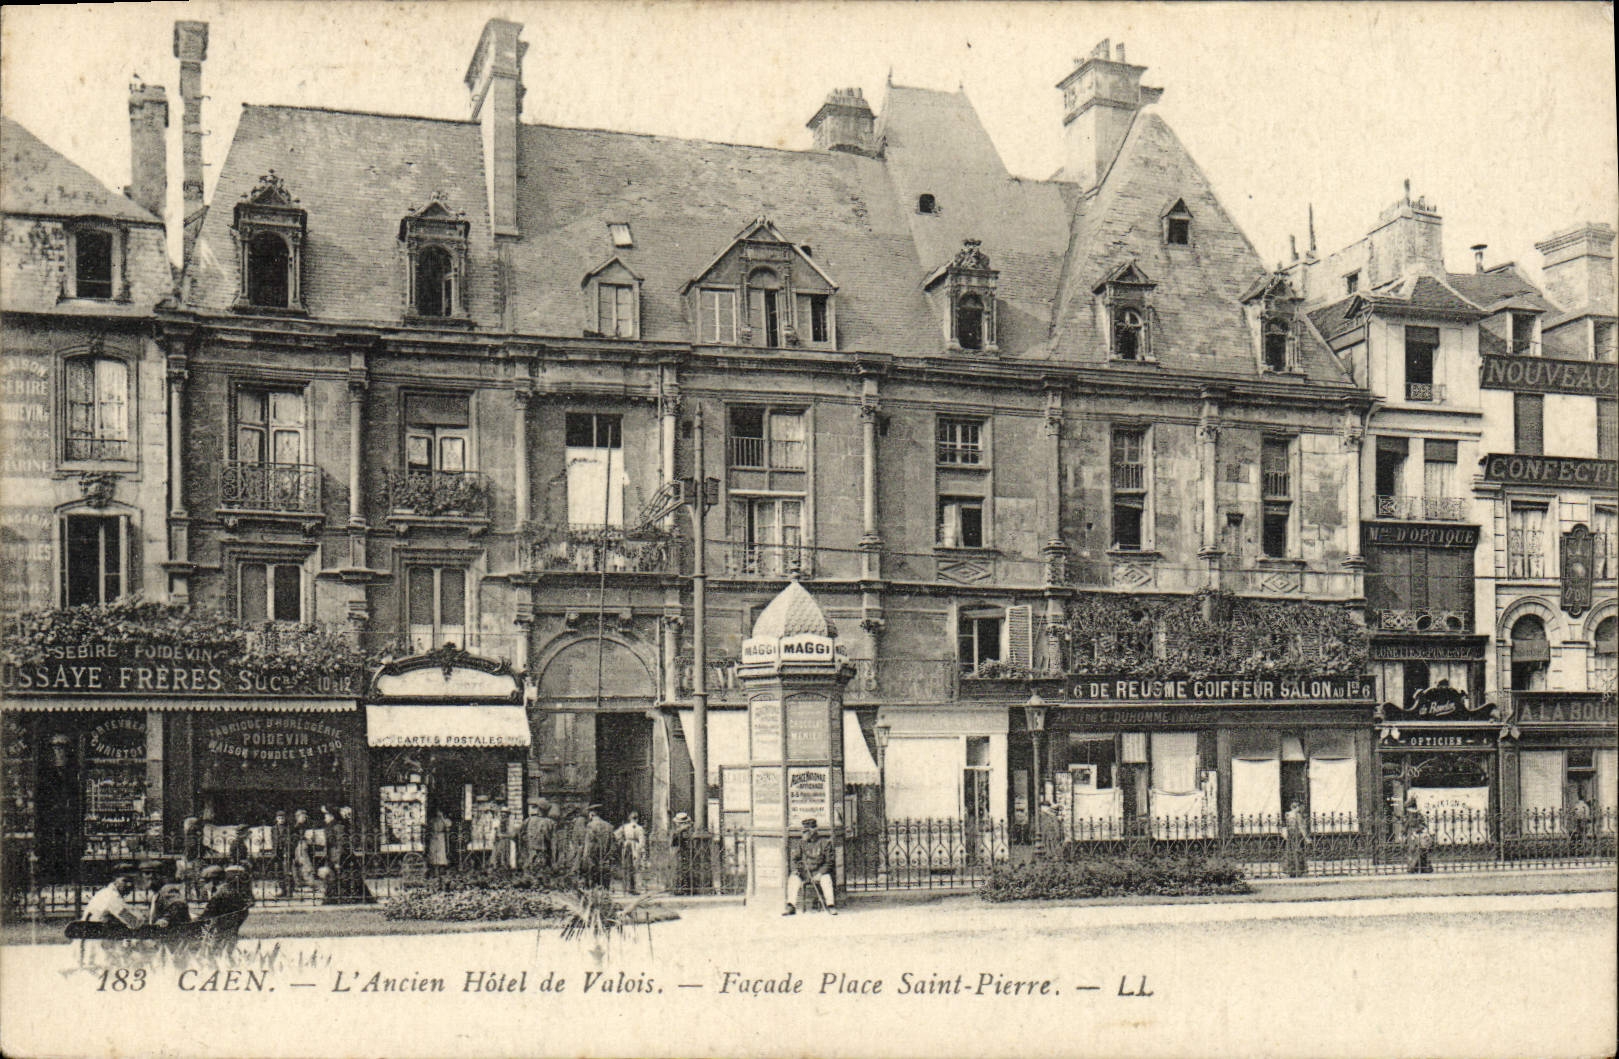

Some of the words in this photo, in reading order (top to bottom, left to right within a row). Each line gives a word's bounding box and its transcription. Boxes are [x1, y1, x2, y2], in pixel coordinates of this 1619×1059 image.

[1487, 358, 1617, 389] NOUVEAU
[1397, 527, 1475, 546] D'OPTIQUE
[134, 644, 212, 661] POIDEVIN
[744, 643, 776, 656] MAGGI
[783, 642, 830, 654] MAGGI
[119, 664, 222, 691] FRÈRES
[1073, 685, 1083, 698] 6
[1090, 683, 1110, 698] DE
[1194, 681, 1274, 699] COIFFEUR
[1280, 681, 1332, 699] SALON
[1362, 684, 1371, 698] 6
[243, 733, 309, 746] POIDEVIN
[397, 736, 440, 745] CARTES
[446, 736, 504, 745] POSTALES
[1410, 736, 1462, 746] OPTICIEN
